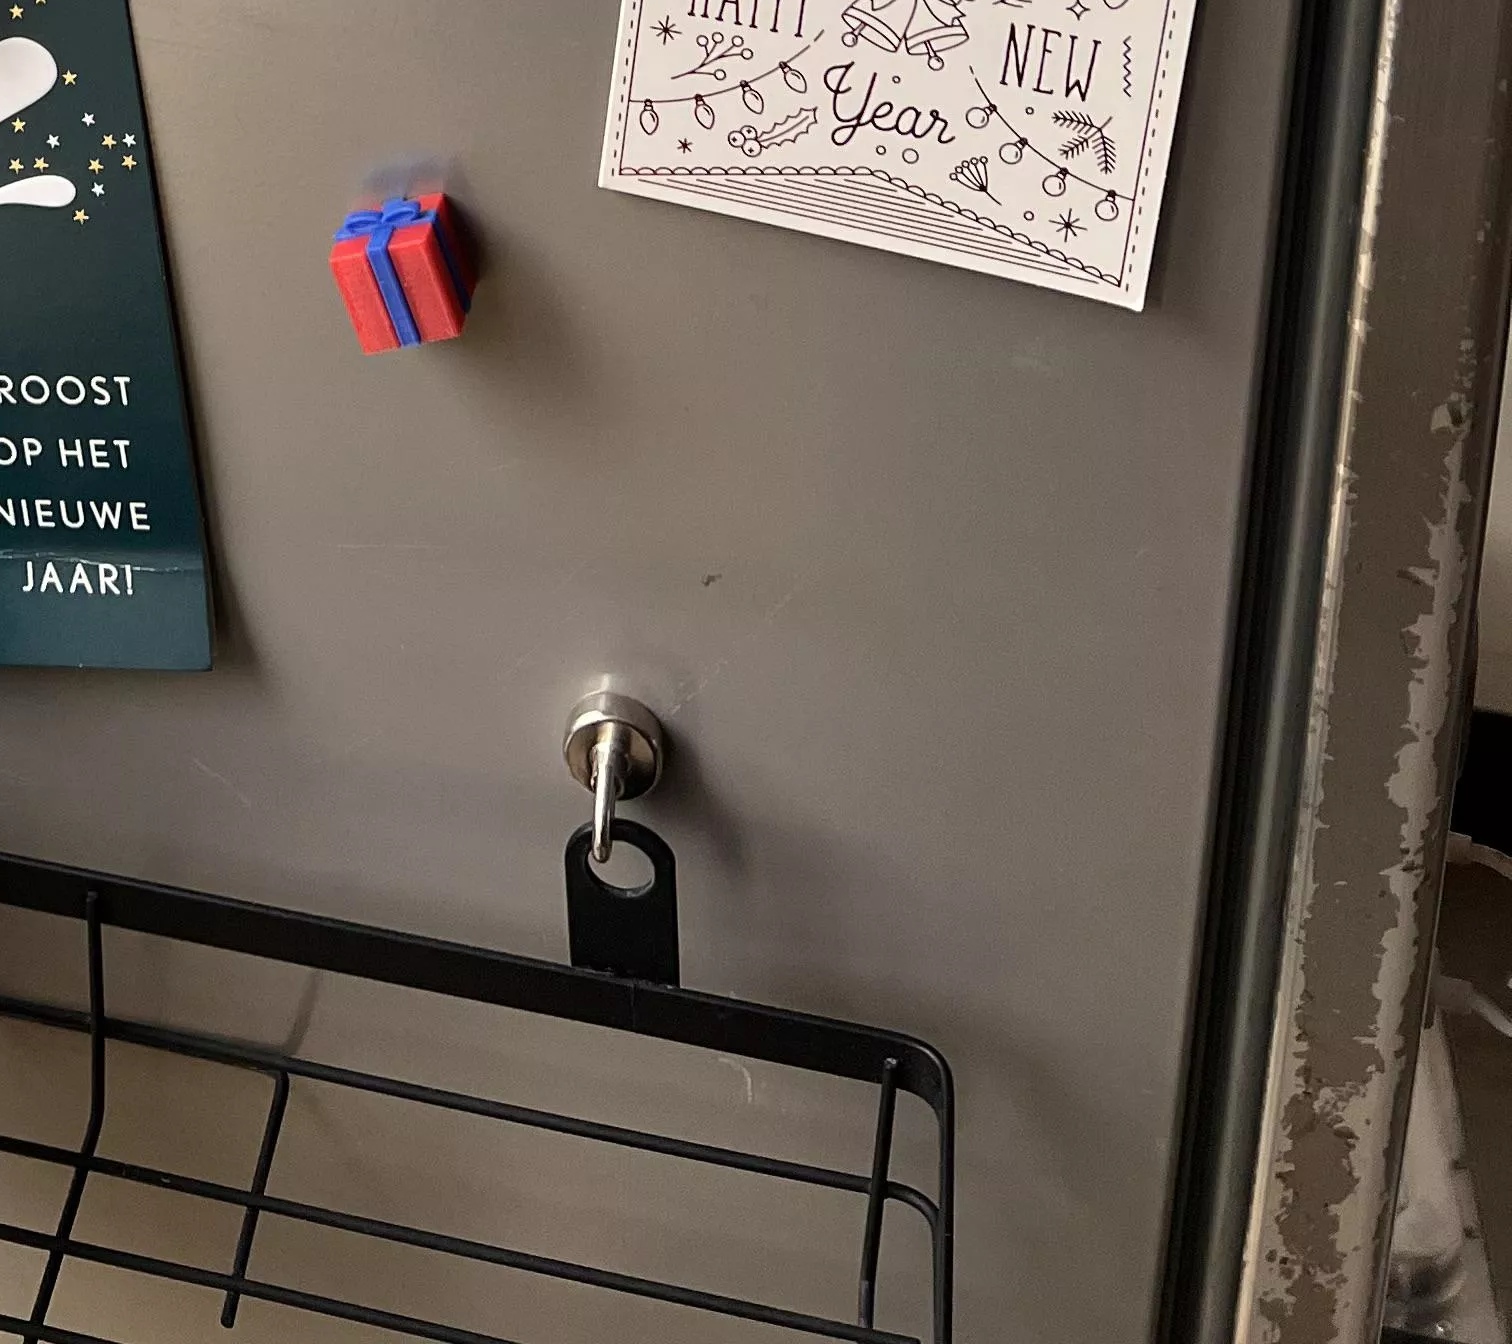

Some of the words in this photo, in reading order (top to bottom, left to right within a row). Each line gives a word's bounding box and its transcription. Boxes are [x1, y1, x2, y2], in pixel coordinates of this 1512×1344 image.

[999, 22, 1101, 102] NEW
[823, 62, 955, 146] Year
[58, 438, 130, 469] HET
[22, 561, 134, 595] JAAR!
